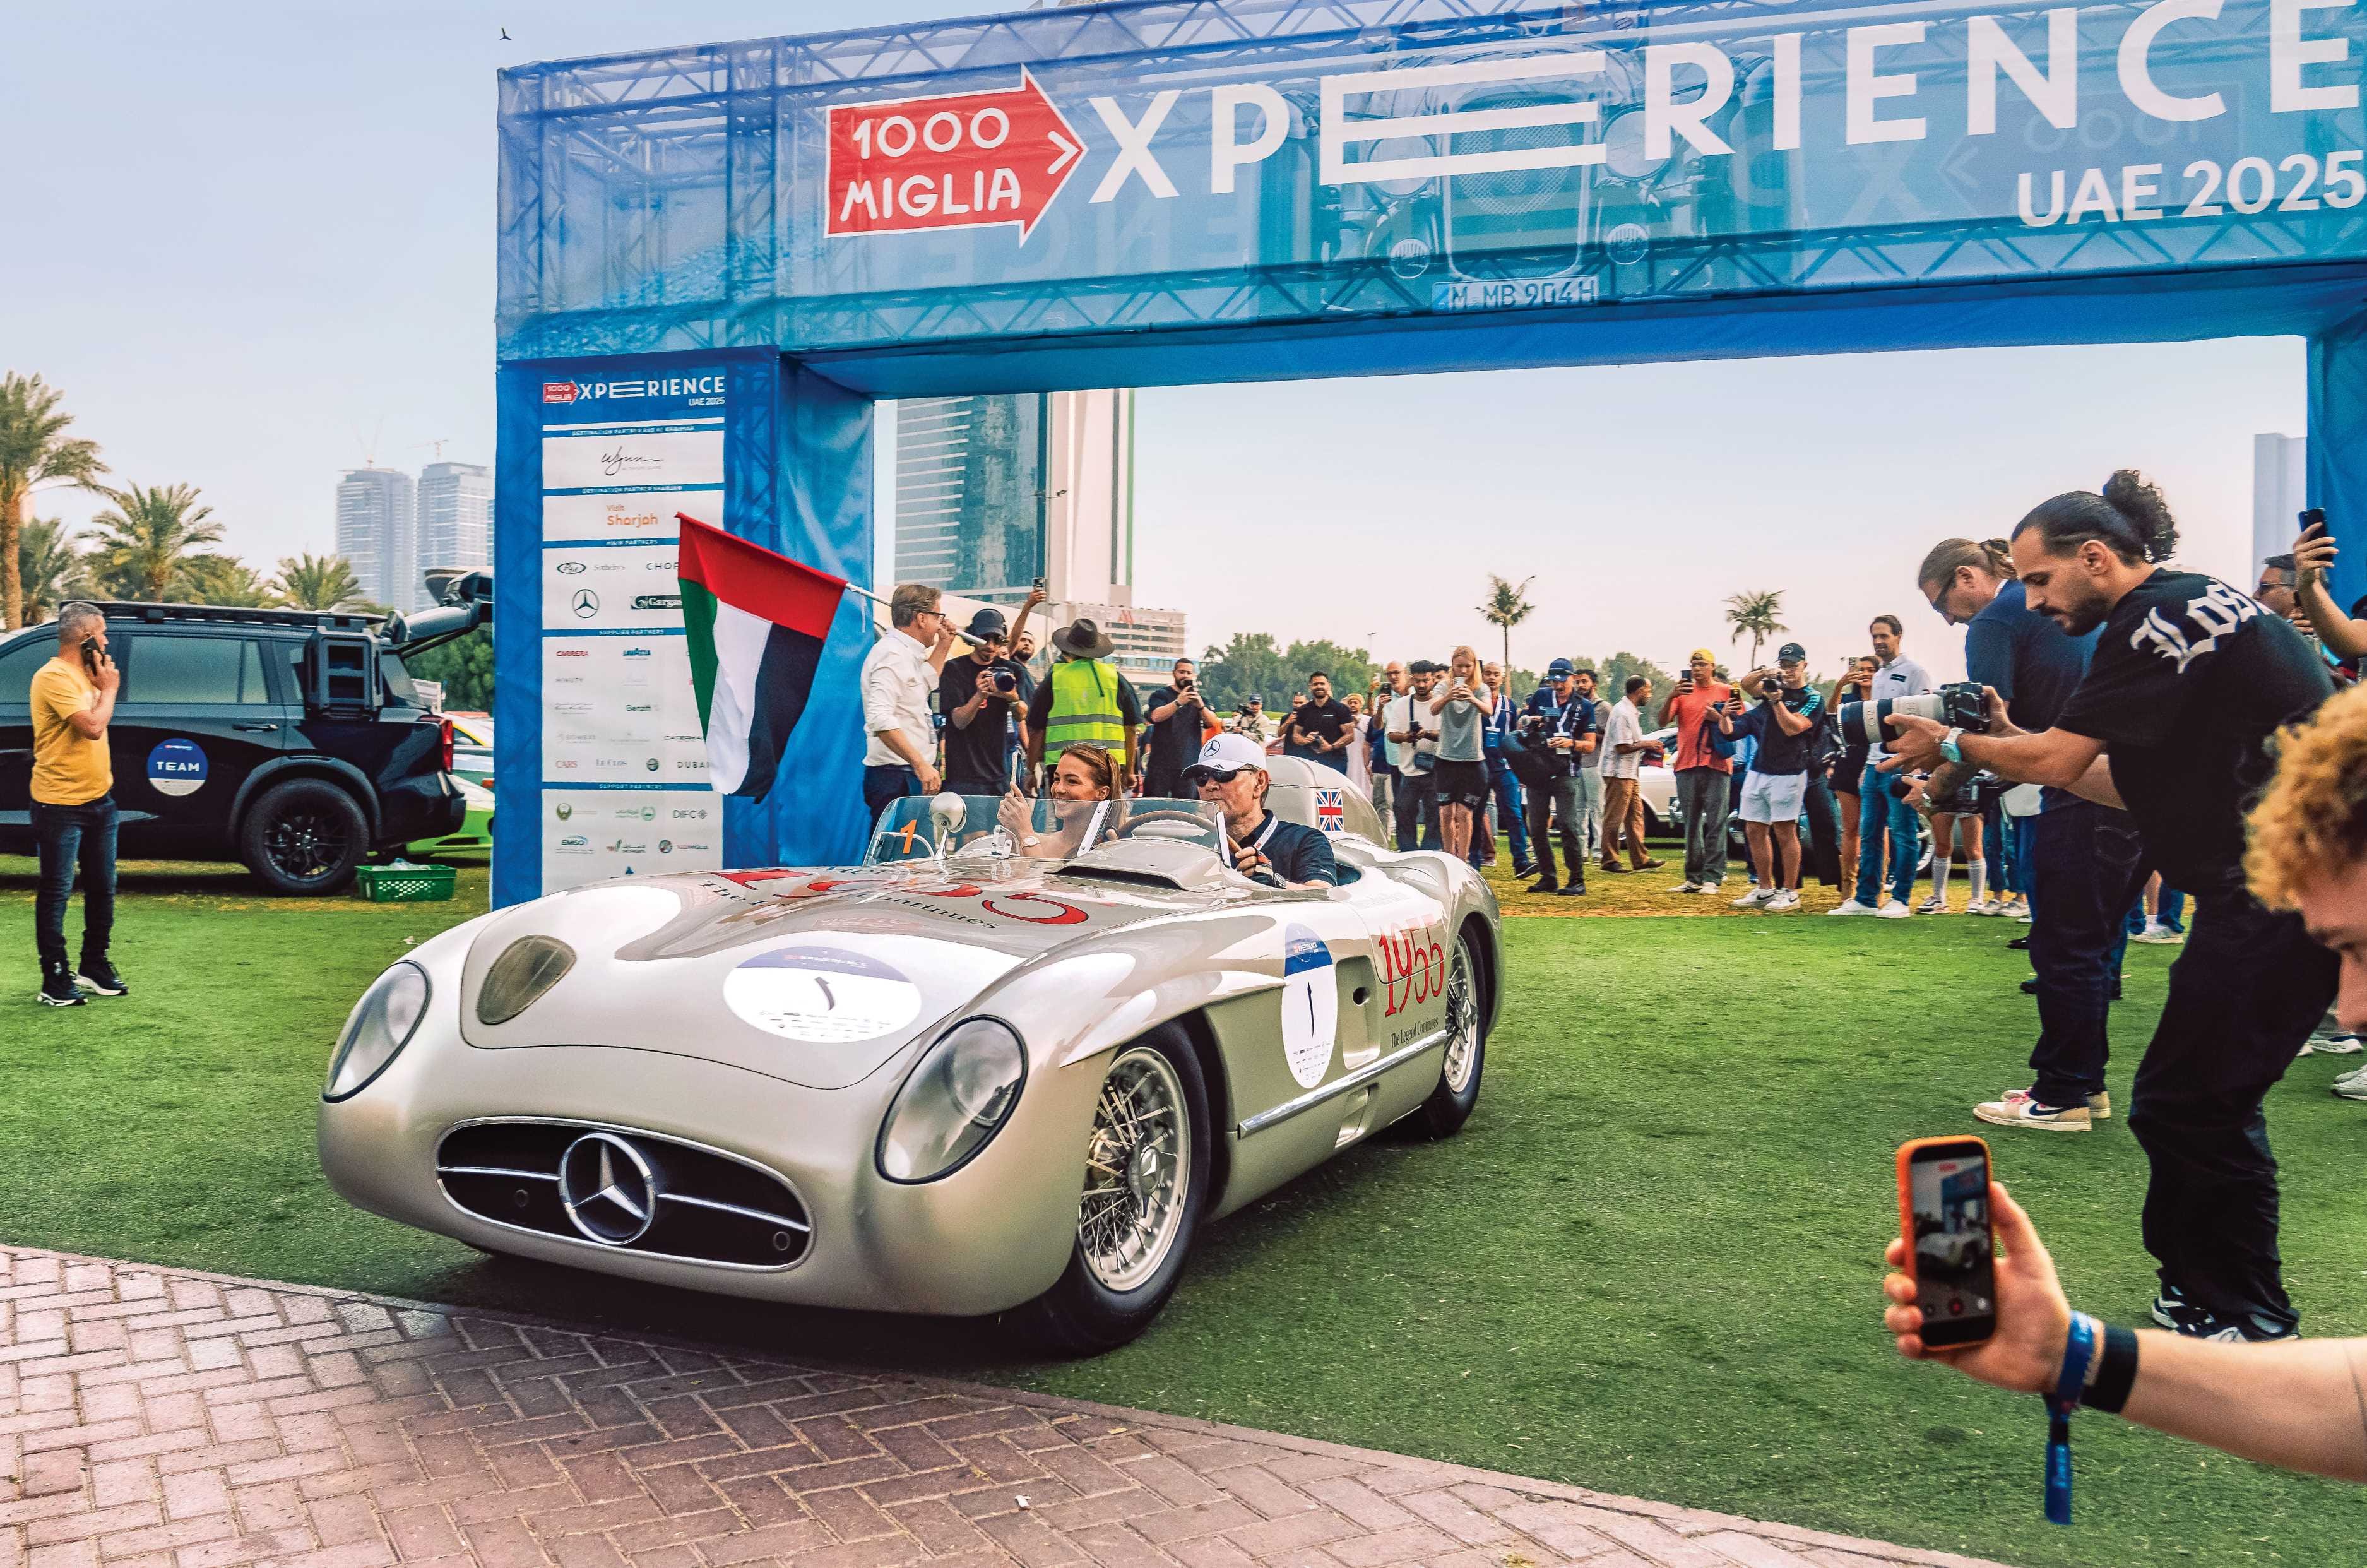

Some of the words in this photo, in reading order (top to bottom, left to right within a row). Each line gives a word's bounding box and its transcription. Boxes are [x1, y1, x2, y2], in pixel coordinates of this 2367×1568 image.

[1089, 0, 2359, 203] XPERIENCE
[853, 107, 1010, 160] 1000
[840, 168, 1021, 222] MIGLIA
[2018, 163, 2164, 227] UAE
[2181, 150, 2365, 218] 2025
[1483, 284, 1514, 308] MB
[545, 393, 572, 401] MIGLIA
[579, 376, 725, 400] XPERIENCE
[689, 398, 704, 406] UAE
[706, 397, 725, 405] 2025
[607, 513, 658, 528] Sharjah
[156, 761, 199, 771] TEAM
[555, 759, 578, 769] CARS
[673, 810, 696, 819] DIFC
[899, 819, 918, 855] 1
[1378, 915, 1445, 1018] 1955
[1391, 1032, 1400, 1048] The
[1401, 1023, 1417, 1044] Legend
[1418, 1017, 1439, 1036] Continues
